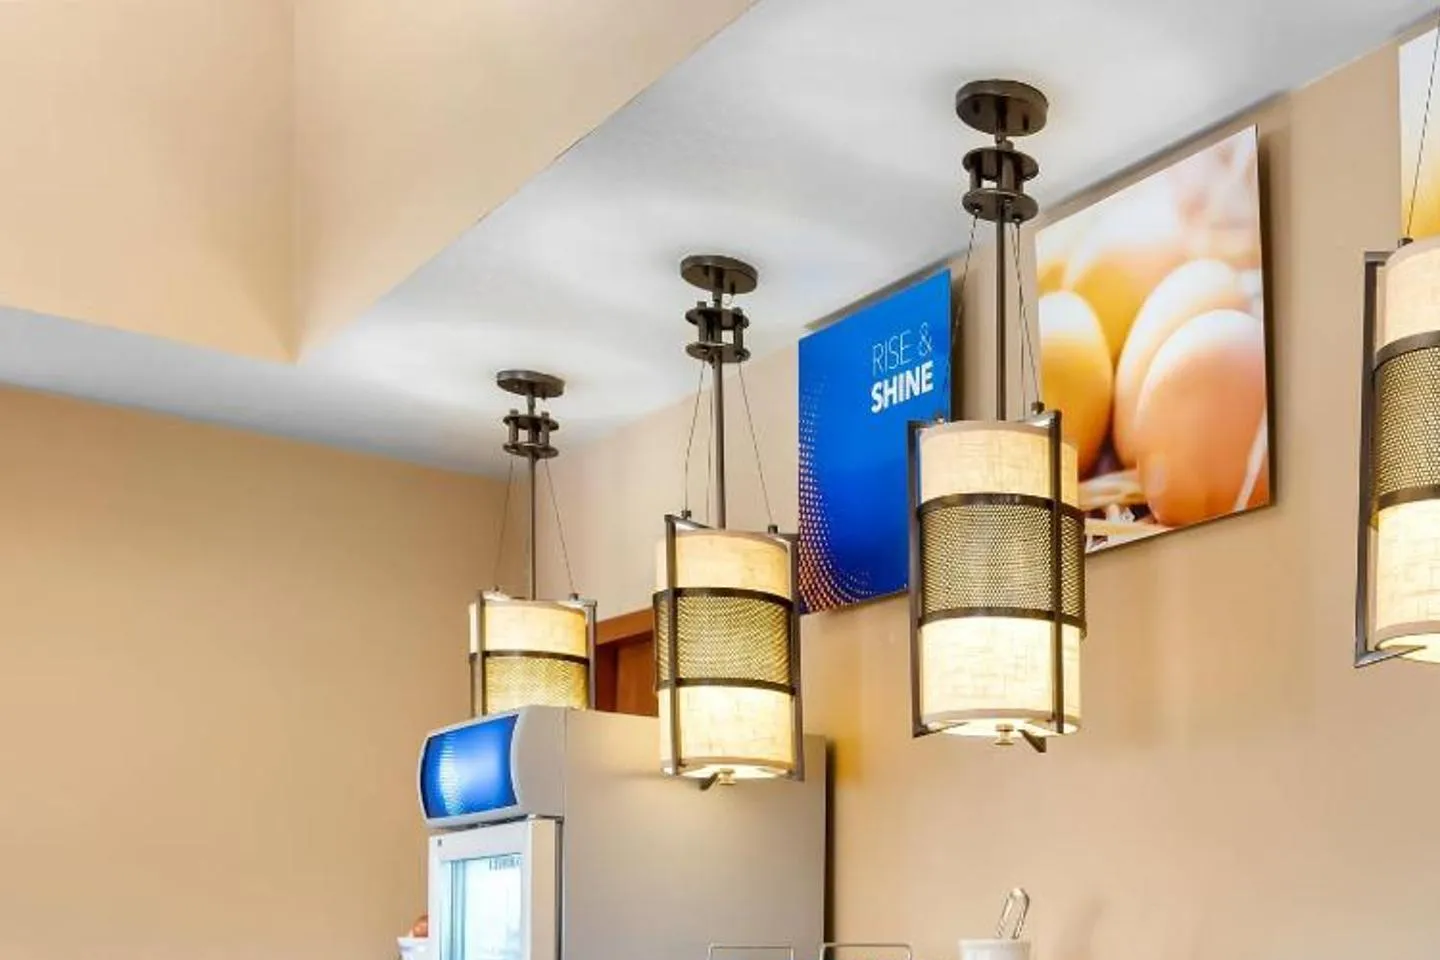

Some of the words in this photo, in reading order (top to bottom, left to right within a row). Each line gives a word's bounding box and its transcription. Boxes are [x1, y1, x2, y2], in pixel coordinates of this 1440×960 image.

[872, 329, 913, 377] RISE
[918, 321, 933, 357] &
[870, 361, 934, 413] SHINE
